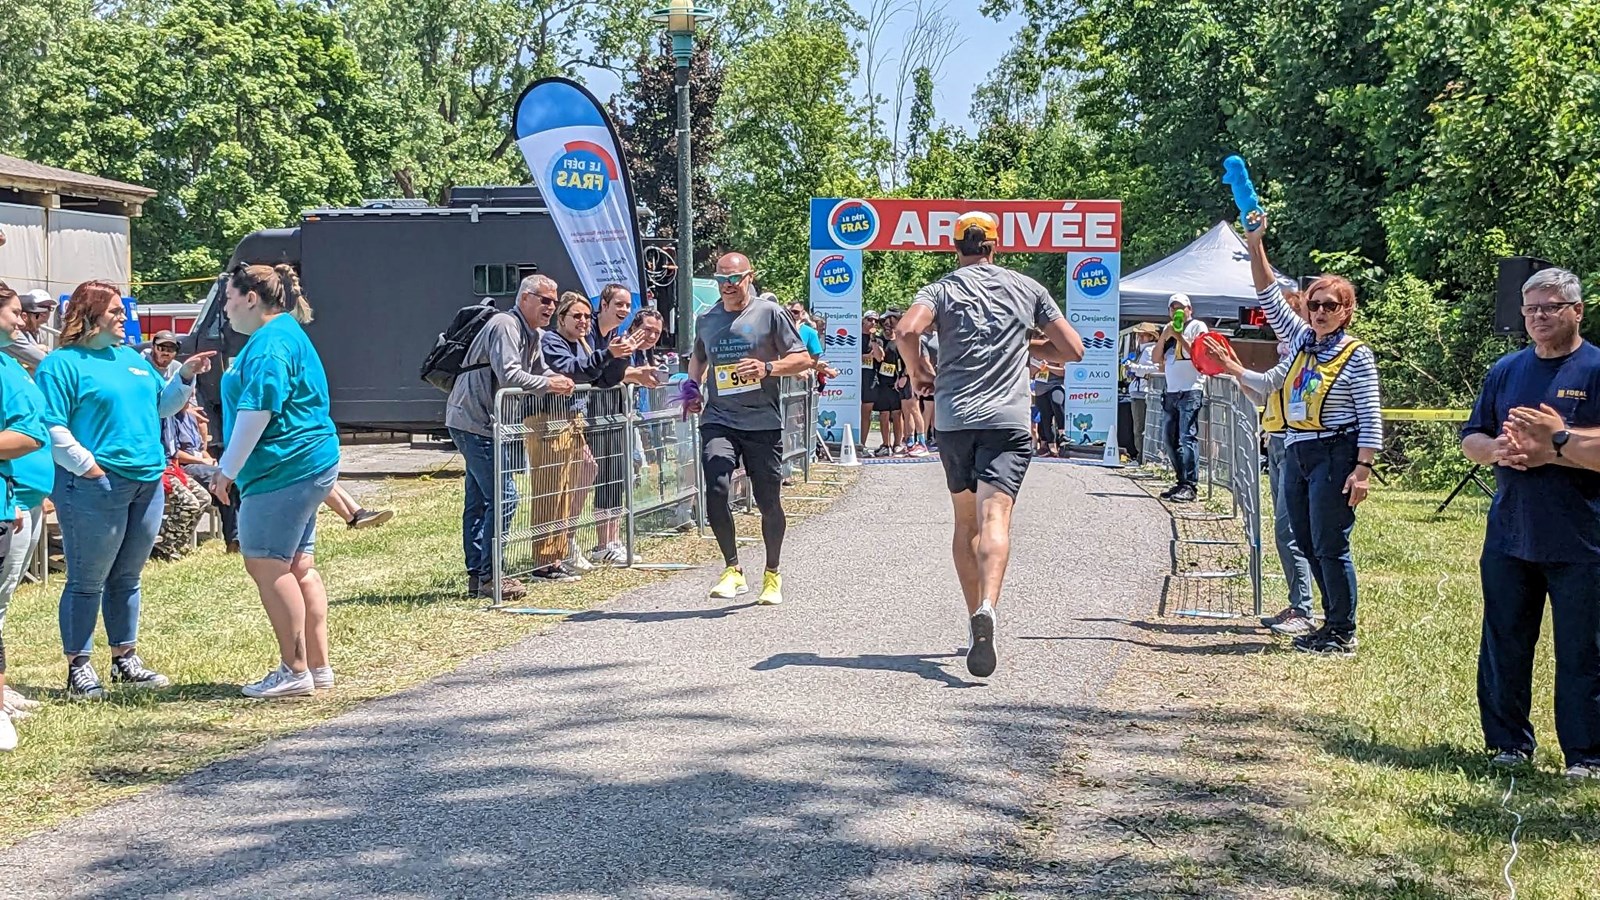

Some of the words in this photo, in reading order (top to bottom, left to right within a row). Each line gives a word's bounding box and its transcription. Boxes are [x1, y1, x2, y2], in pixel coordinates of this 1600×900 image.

[840, 220, 870, 234] FRAS
[890, 202, 1117, 248] ARIVÉE
[822, 273, 850, 286] FRAS
[1080, 275, 1108, 289] FRAS
[824, 312, 858, 320] Desjardins
[1081, 314, 1116, 323] Desjardins
[818, 388, 843, 397] etro
[1068, 392, 1100, 401] metro
